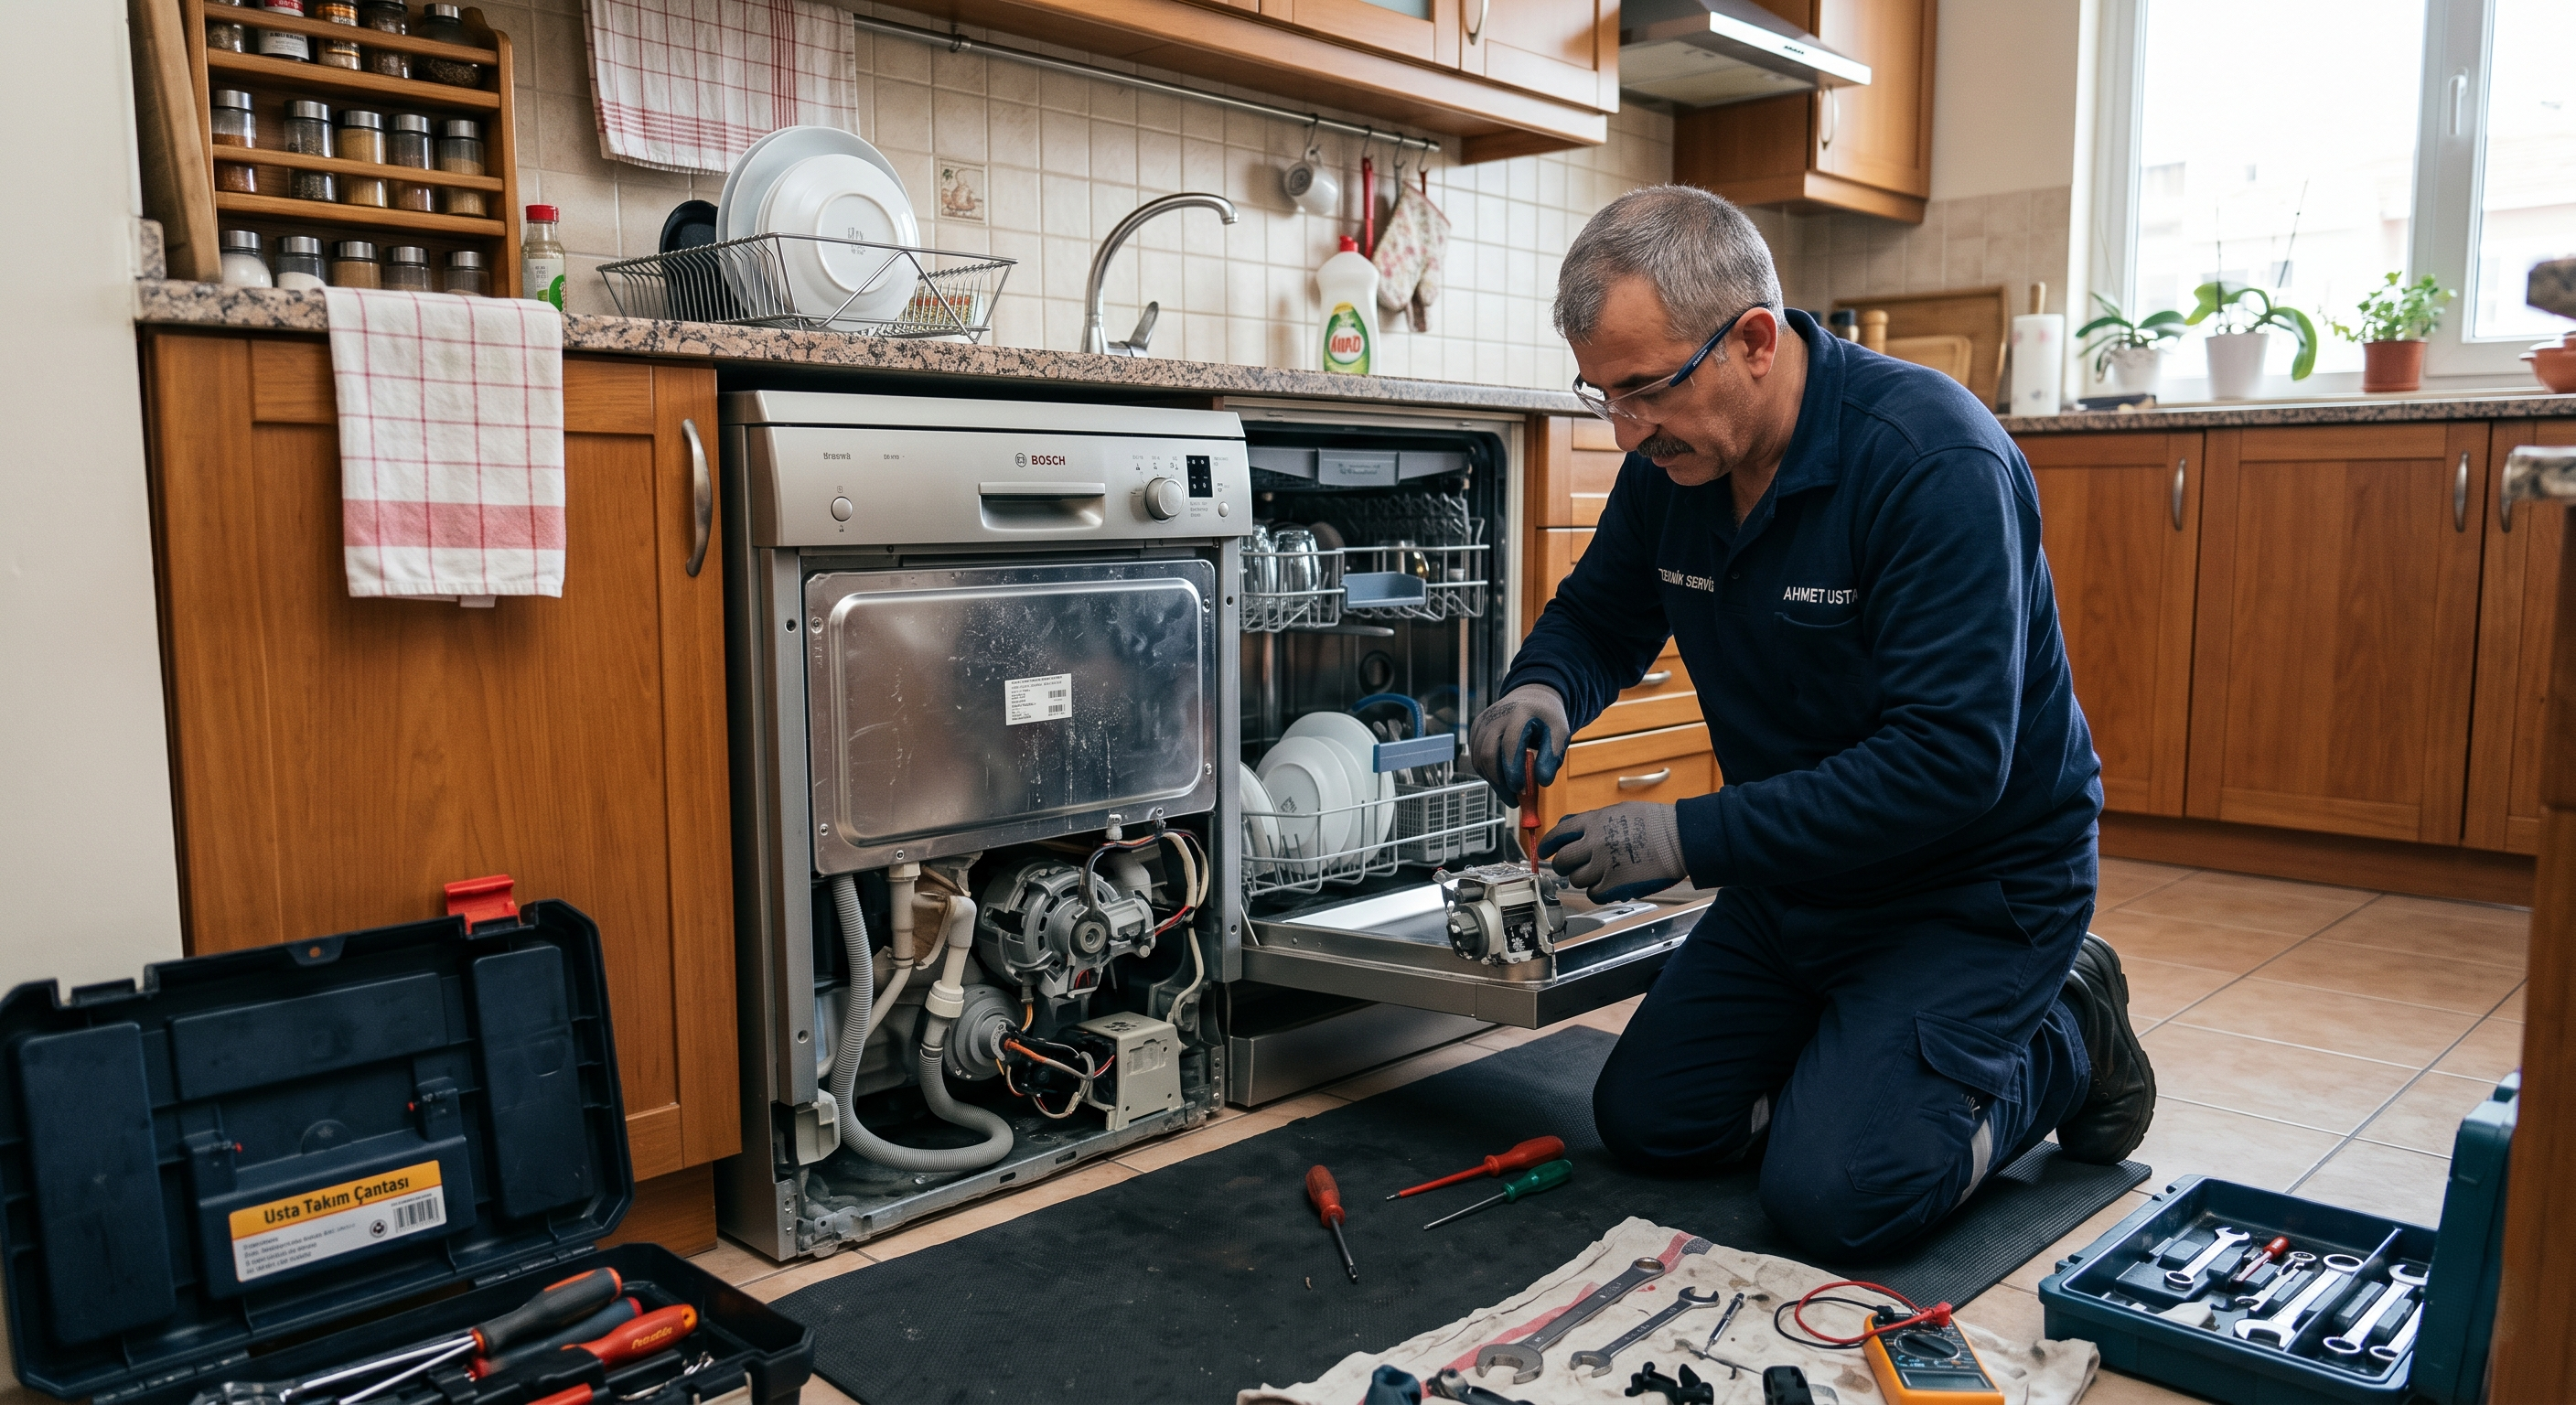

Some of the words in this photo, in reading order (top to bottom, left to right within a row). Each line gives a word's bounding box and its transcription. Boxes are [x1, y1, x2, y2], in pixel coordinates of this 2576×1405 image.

[1031, 455, 1066, 466] BOSCH
[1783, 585, 1825, 604] AHMET
[263, 1205, 300, 1224] Usta
[303, 1191, 349, 1214] Takım
[354, 1177, 409, 1206] Çantası
